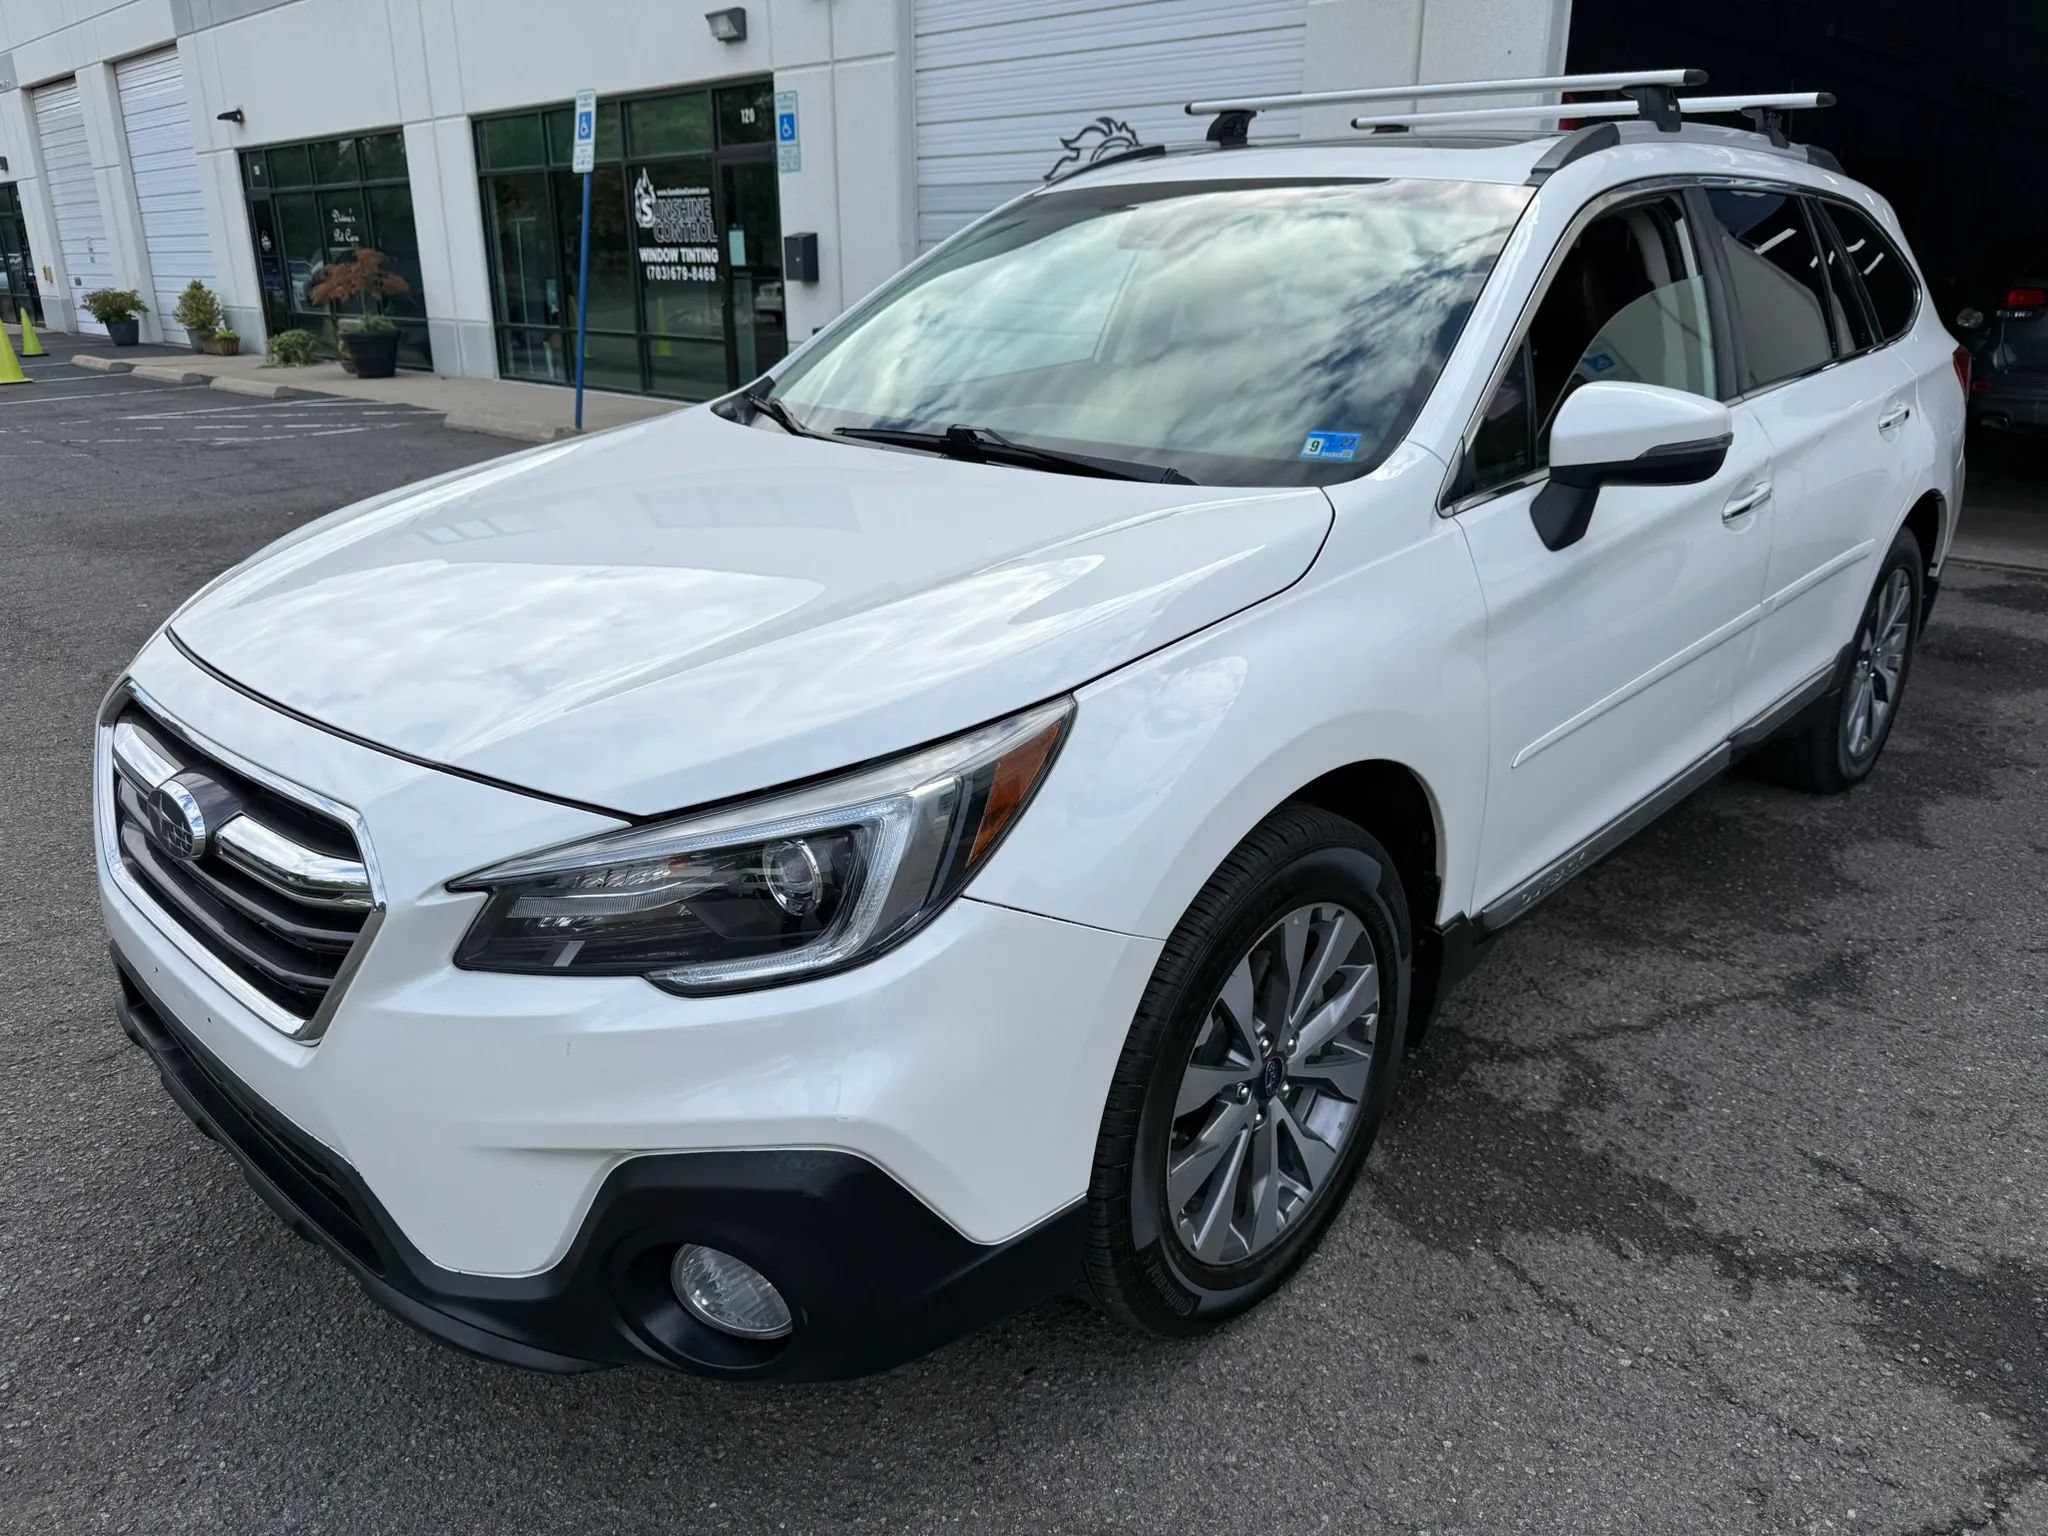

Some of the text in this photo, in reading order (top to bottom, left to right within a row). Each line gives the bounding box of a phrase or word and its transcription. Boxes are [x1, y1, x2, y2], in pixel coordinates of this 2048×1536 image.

[741, 108, 755, 123] 120
[641, 196, 713, 221] SUNSHINE
[653, 221, 719, 244] CONTROL
[639, 247, 719, 264] WINDOW TINTING
[1309, 440, 1320, 452] 9
[1145, 1261, 1194, 1317] Continental
